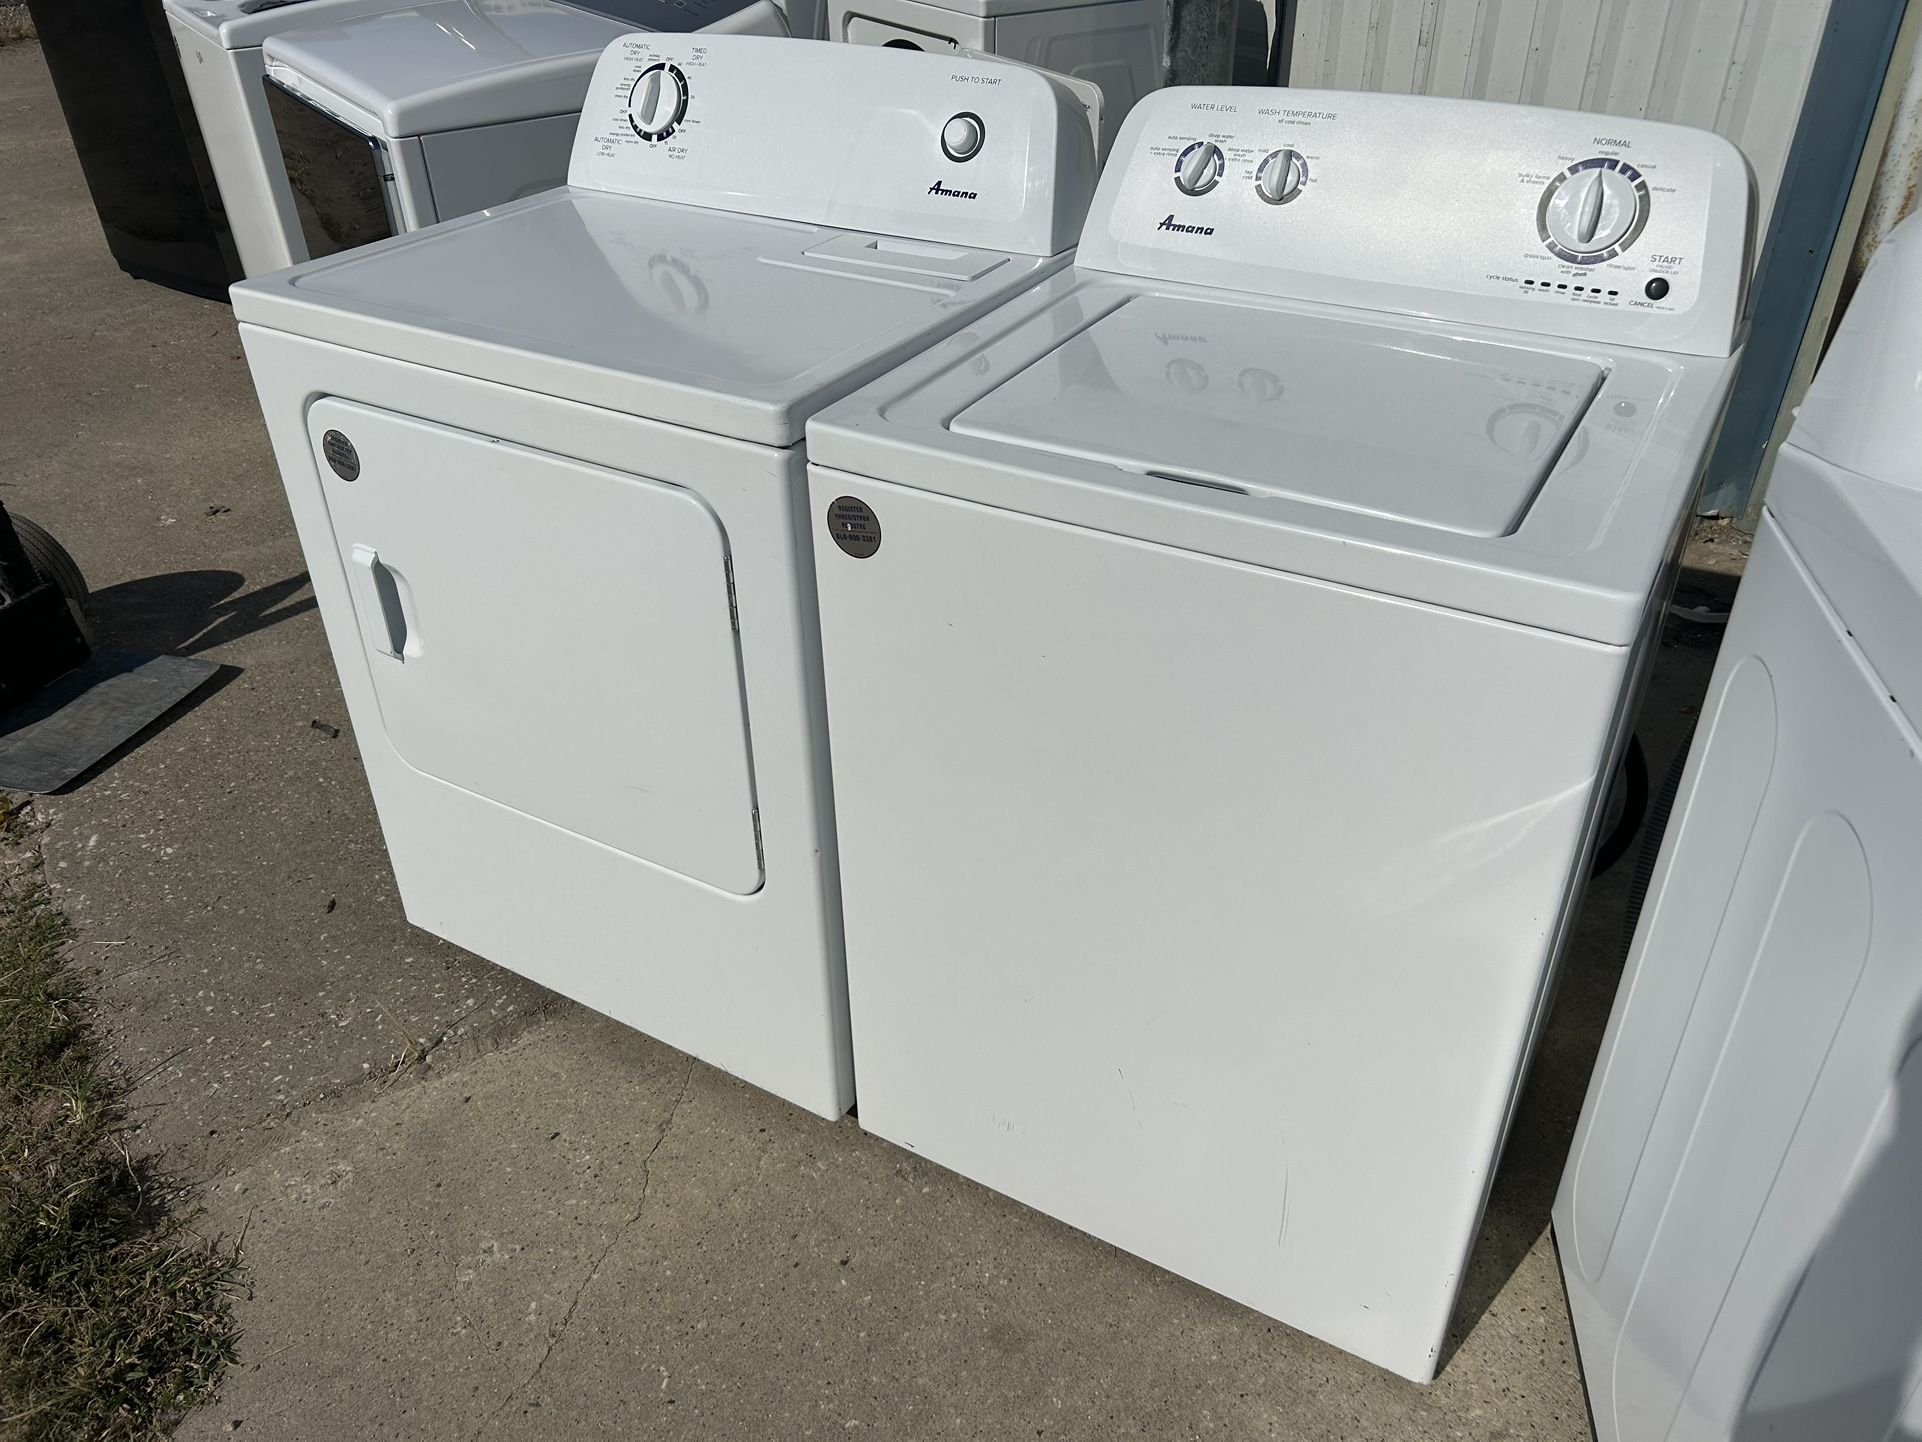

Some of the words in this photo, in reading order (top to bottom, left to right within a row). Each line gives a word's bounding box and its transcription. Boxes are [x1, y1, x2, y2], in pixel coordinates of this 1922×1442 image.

[623, 42, 651, 50] AUTOMATIC
[1191, 103, 1215, 111] WATER
[1216, 104, 1238, 113] LEVEL
[1258, 108, 1280, 116] WASH
[1282, 109, 1338, 120] TEMPERATURE
[594, 136, 622, 145] AUTOMATIC
[1593, 137, 1632, 148] NORMAL
[928, 181, 977, 199] Amana
[1157, 214, 1214, 235] Amana
[1649, 254, 1684, 265] START
[1575, 265, 1595, 273] washer
[1629, 300, 1654, 309] CANCEL
